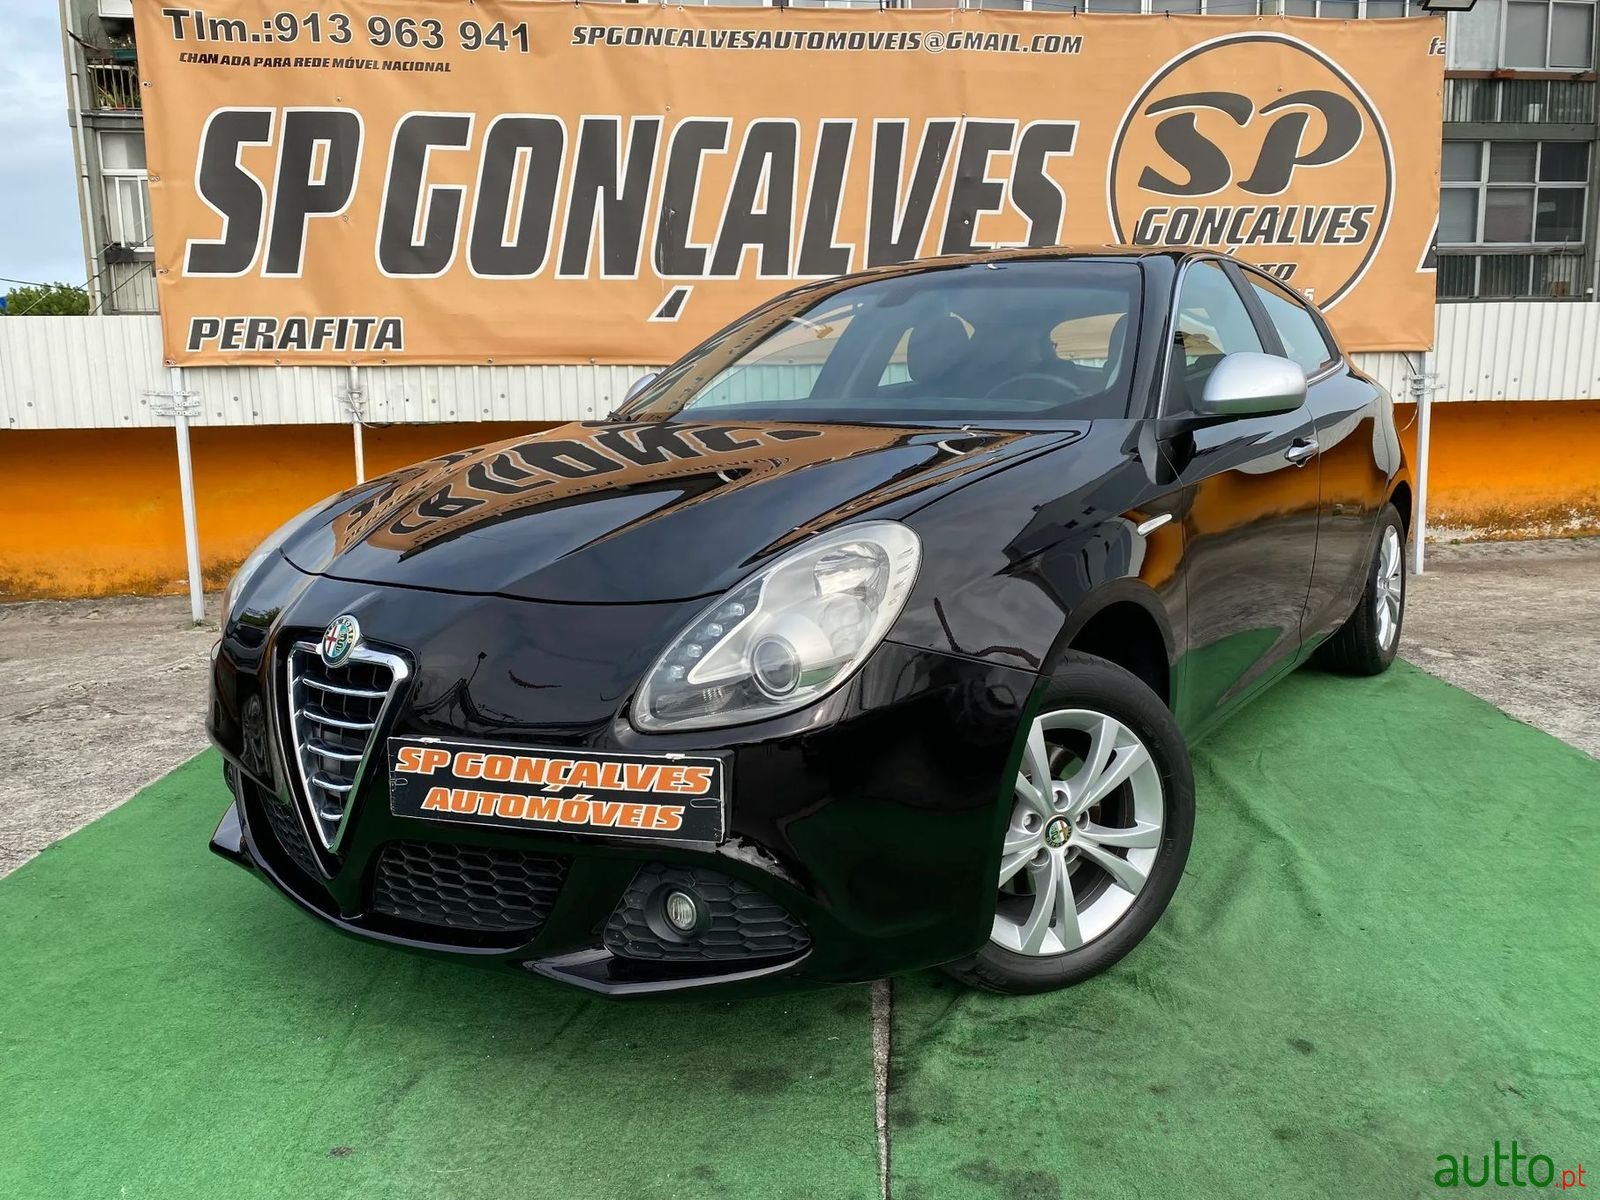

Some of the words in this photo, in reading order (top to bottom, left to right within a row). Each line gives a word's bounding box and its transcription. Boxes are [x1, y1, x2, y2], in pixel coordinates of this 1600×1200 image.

[367, 17, 445, 51] 963
[458, 20, 531, 54] 941
[570, 23, 1084, 55] SPGONCALVESAUTOMOVEIS@GMAIL.COM
[253, 57, 292, 68] PARA
[293, 57, 330, 69] REDE
[332, 56, 379, 70] MÓVEL
[382, 60, 452, 73] NACIONAL
[1137, 90, 1364, 197] SP
[182, 106, 365, 279] SP
[374, 110, 1081, 322] GONÇALVES
[1134, 204, 1377, 256] GONÇALVES
[185, 315, 405, 352] PERAFITA
[395, 746, 451, 775] SP
[453, 752, 715, 796] GONÇALVES
[420, 787, 685, 831] AUTOMÓVEIS
